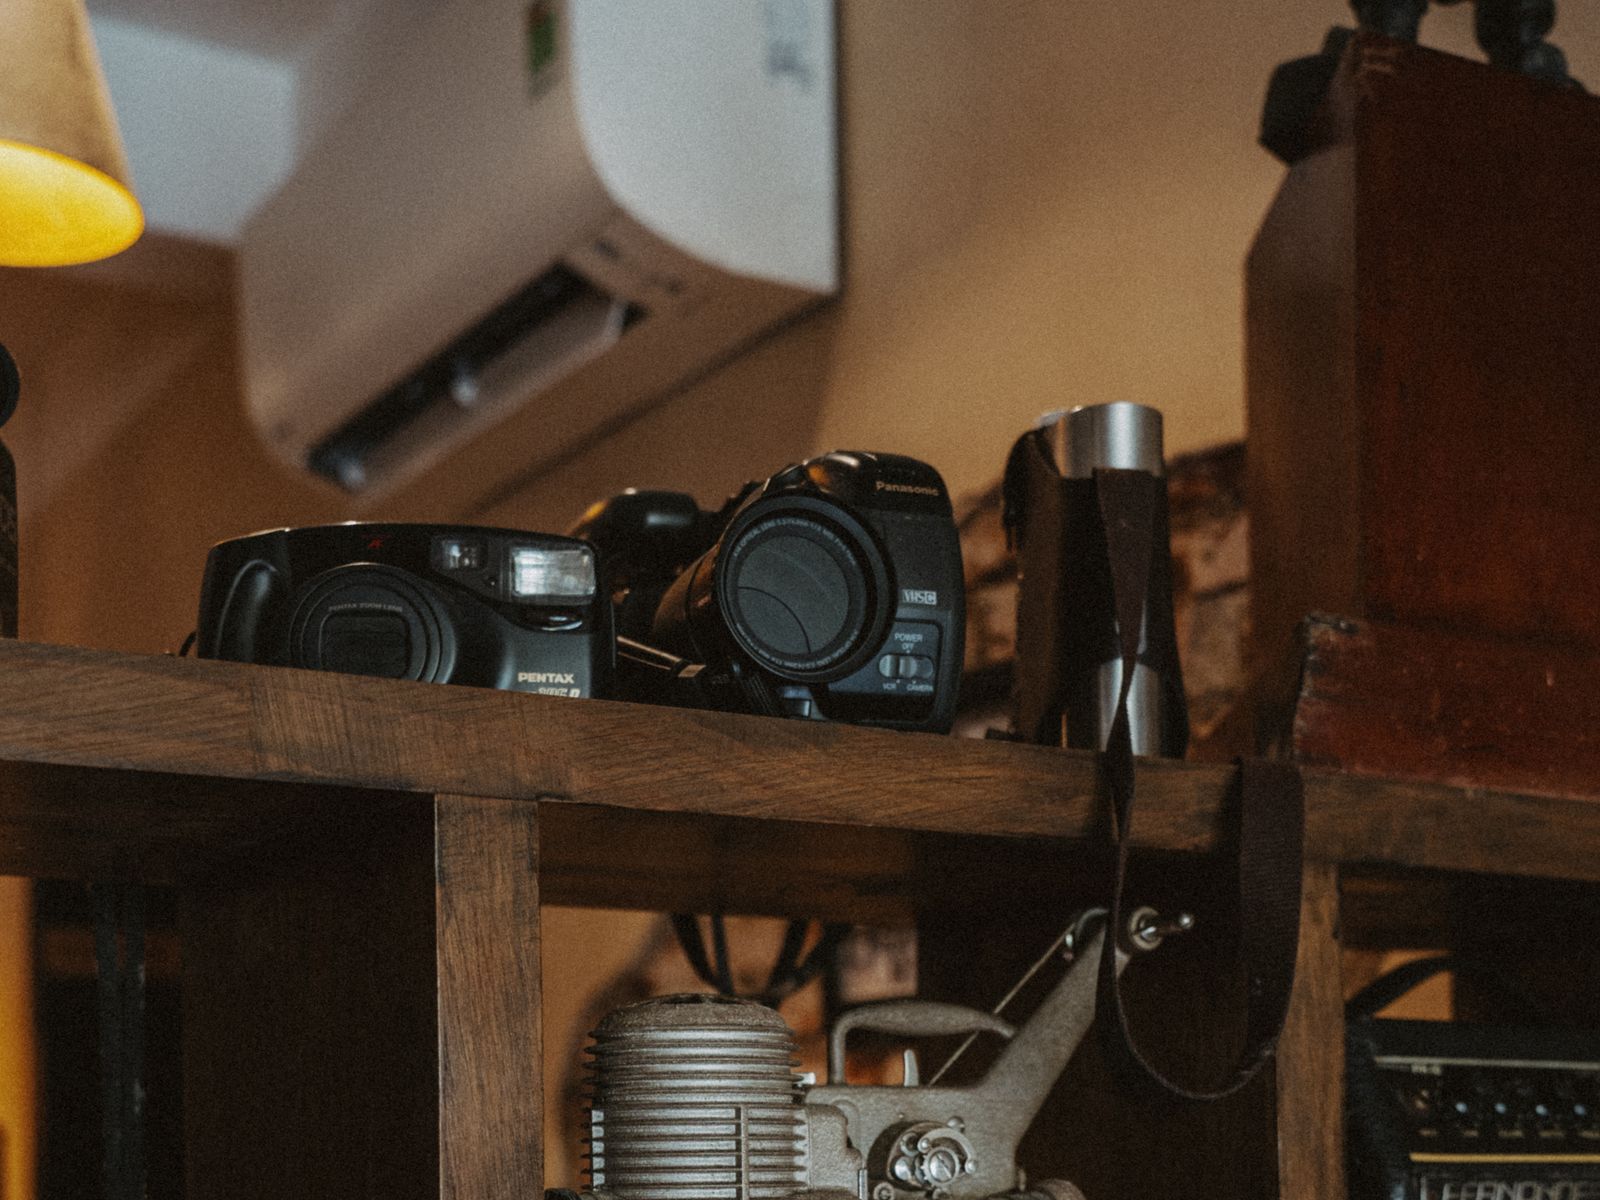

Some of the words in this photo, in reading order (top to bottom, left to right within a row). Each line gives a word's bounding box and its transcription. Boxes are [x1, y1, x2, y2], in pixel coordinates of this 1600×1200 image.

[875, 480, 940, 497] Panasonic
[894, 632, 923, 642] POWER
[901, 642, 915, 651] OFF
[518, 672, 575, 684] PENTAX
